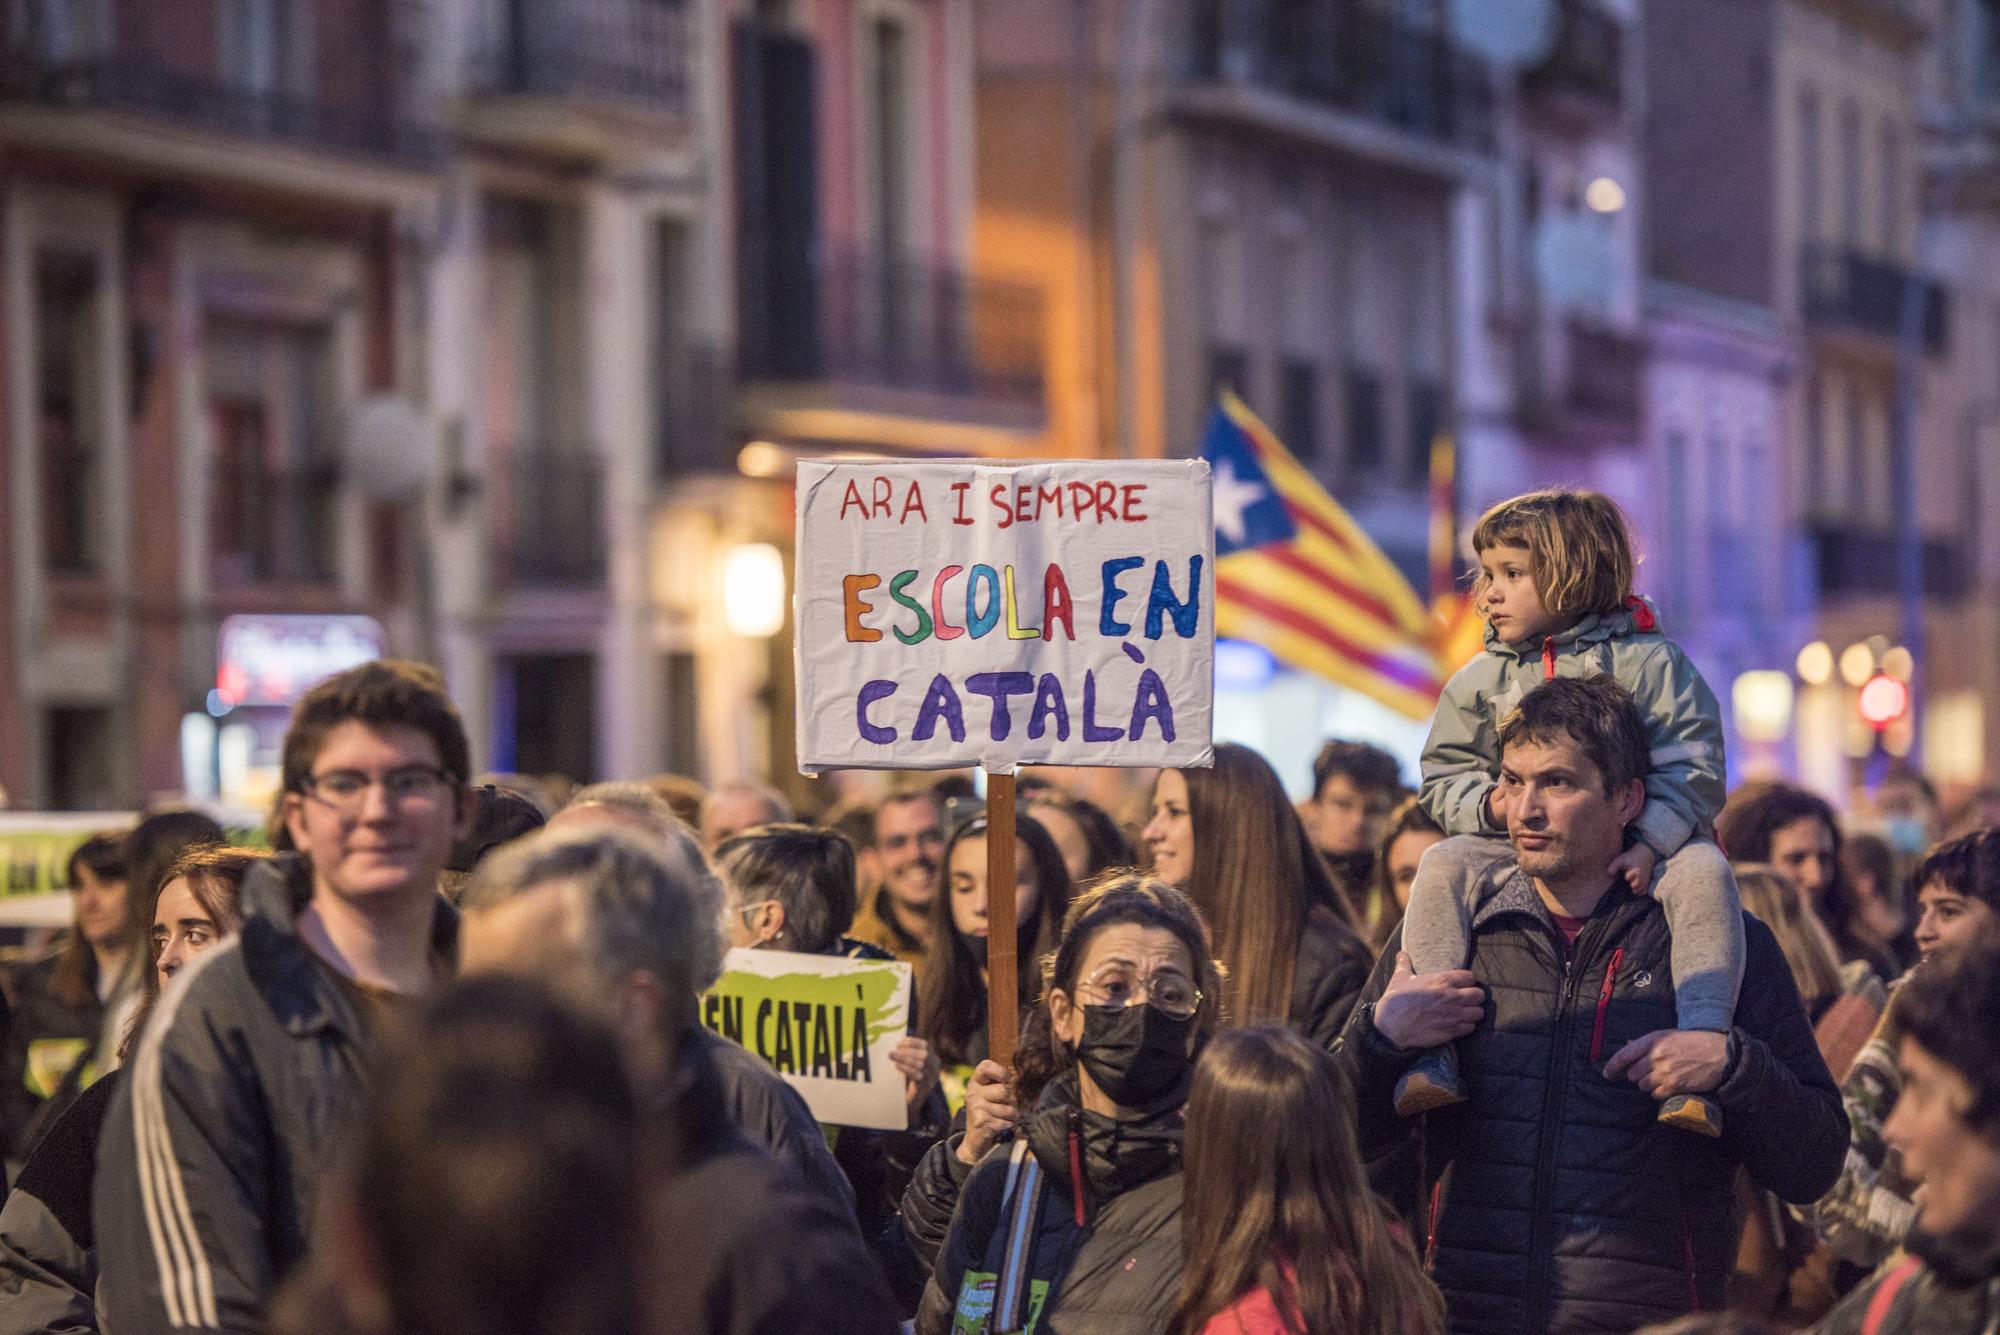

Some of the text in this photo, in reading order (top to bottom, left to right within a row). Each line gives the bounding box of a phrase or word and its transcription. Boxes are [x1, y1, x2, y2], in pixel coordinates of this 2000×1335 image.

[840, 476, 1149, 529] ARA I SEMPRE
[842, 554, 1204, 645] ESCOLA EN
[856, 641, 1177, 745] CATALÀ
[756, 984, 872, 1083] CATALÀ
